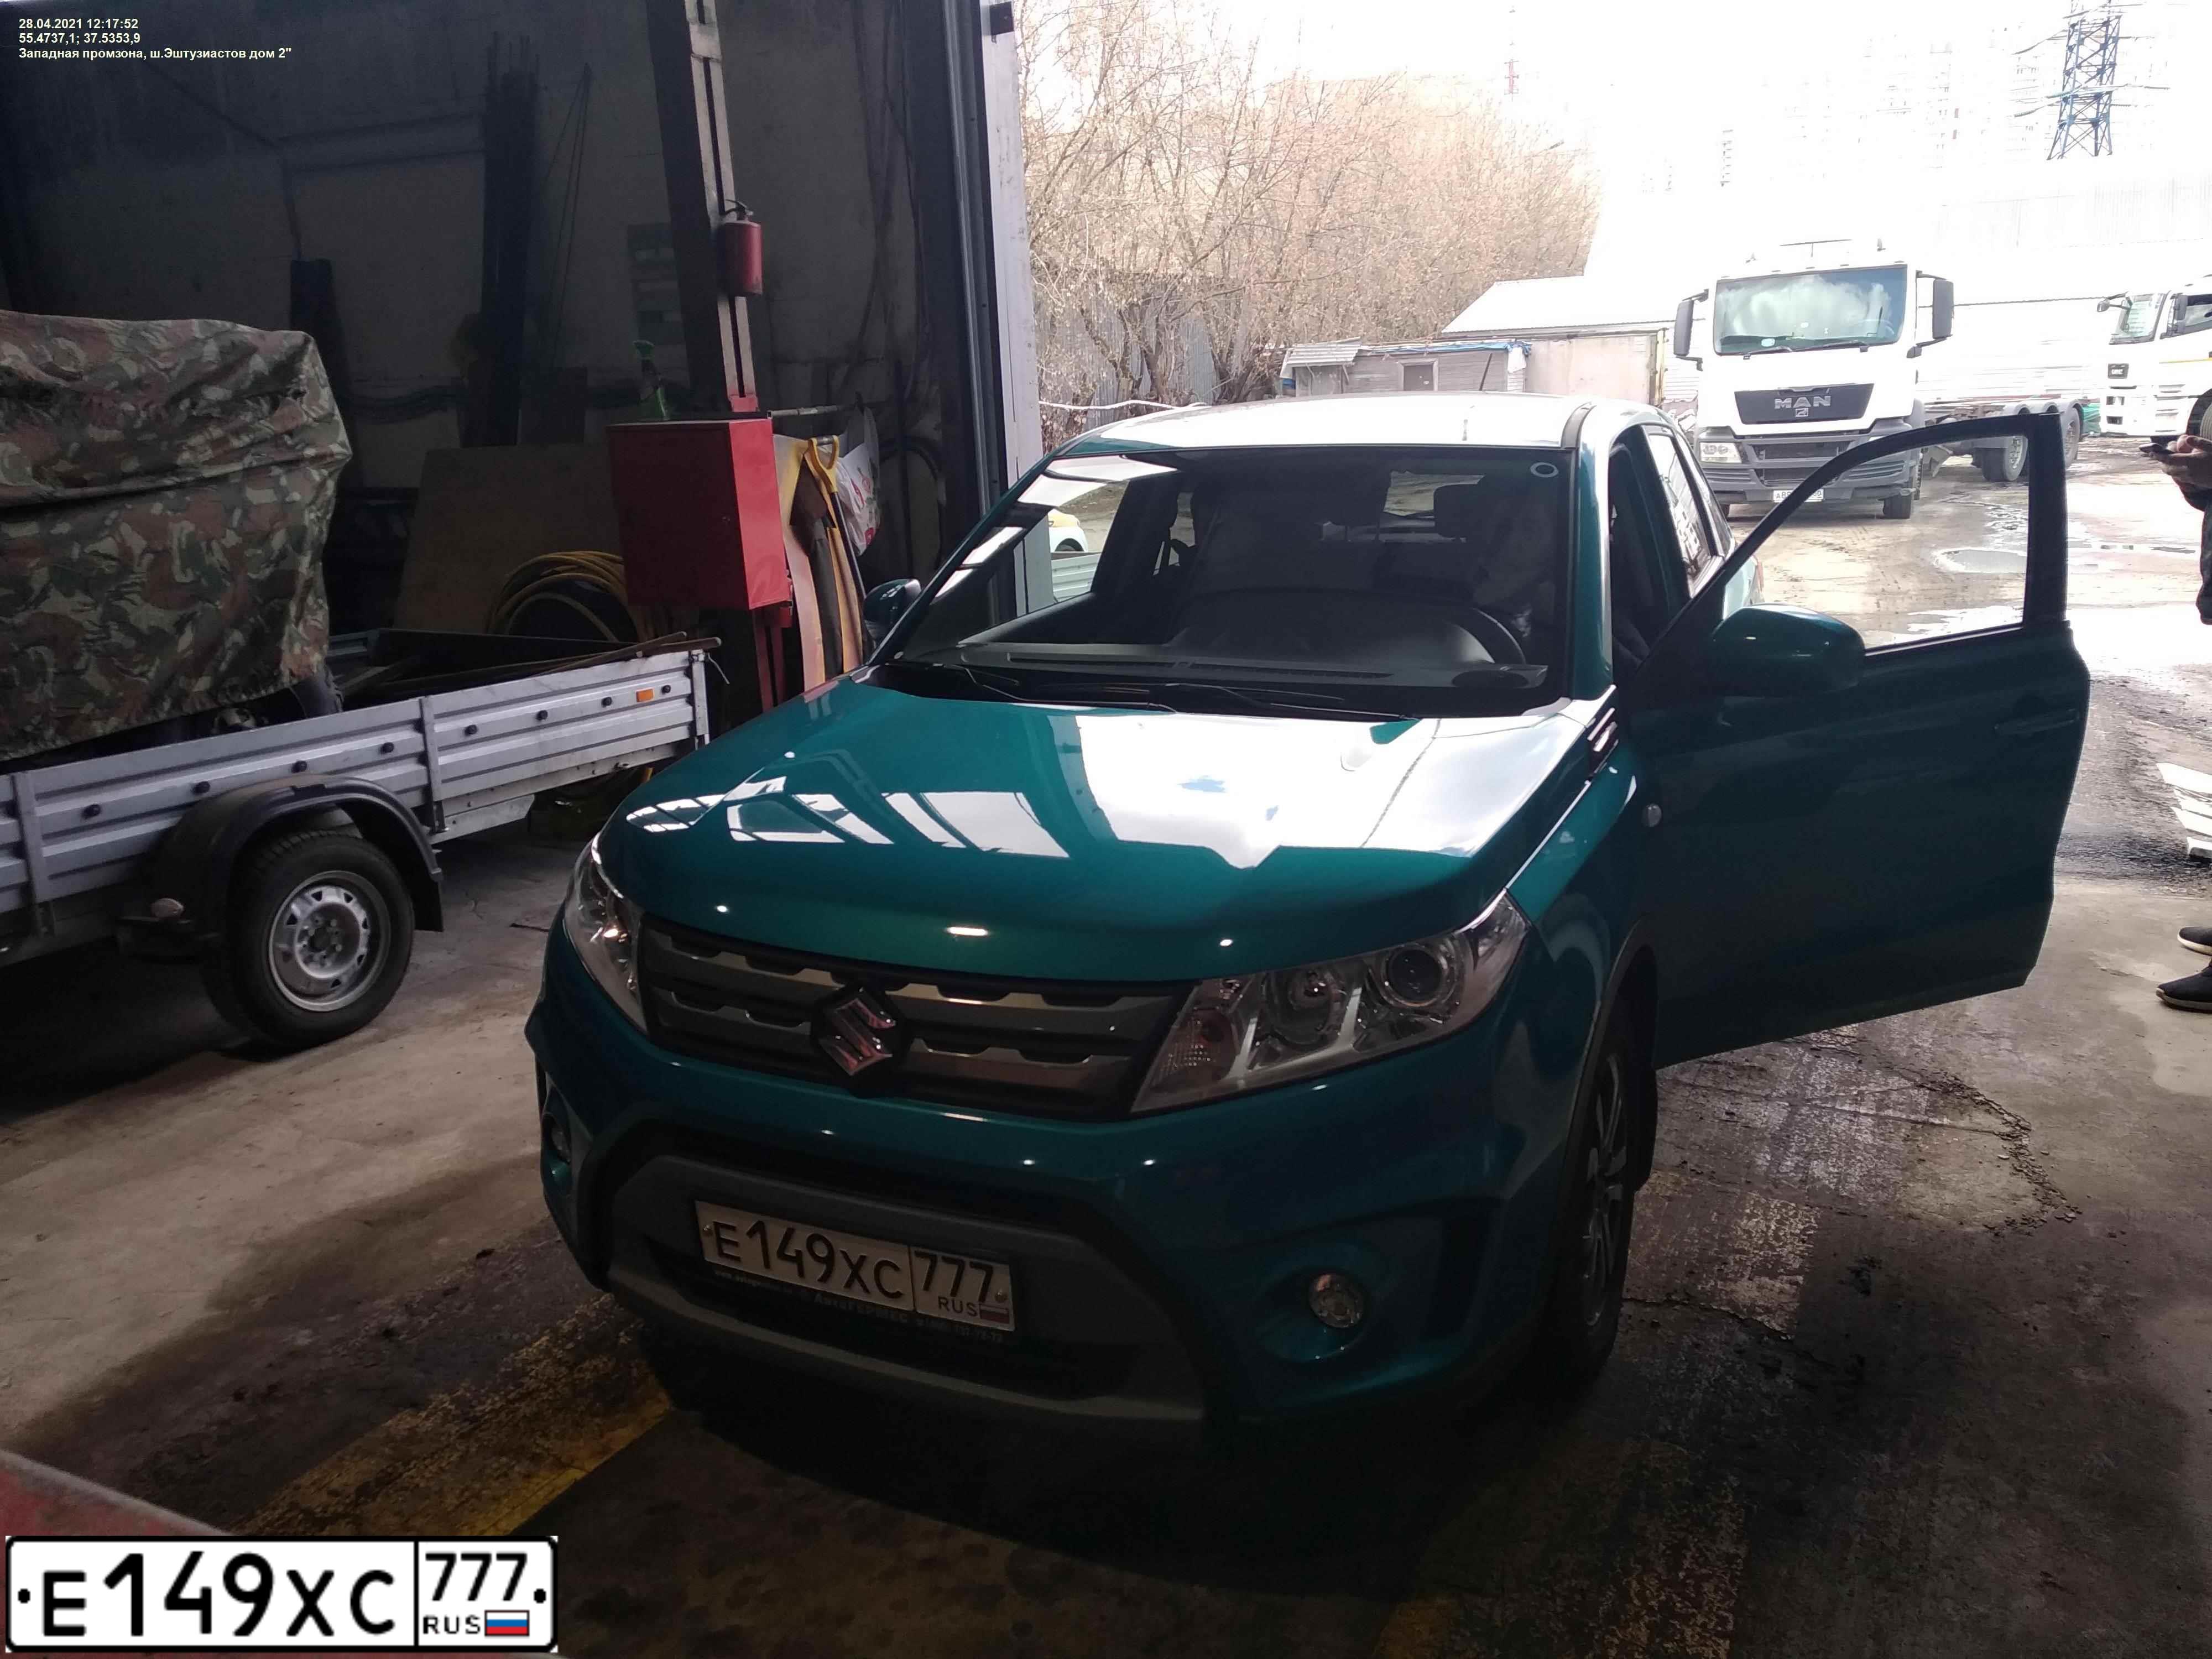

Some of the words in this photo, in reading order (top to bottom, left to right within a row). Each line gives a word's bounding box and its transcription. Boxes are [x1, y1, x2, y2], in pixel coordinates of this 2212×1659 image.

[1774, 395, 1831, 409] MAN
[915, 1251, 994, 1302] 777
[937, 1296, 978, 1317] RUS
